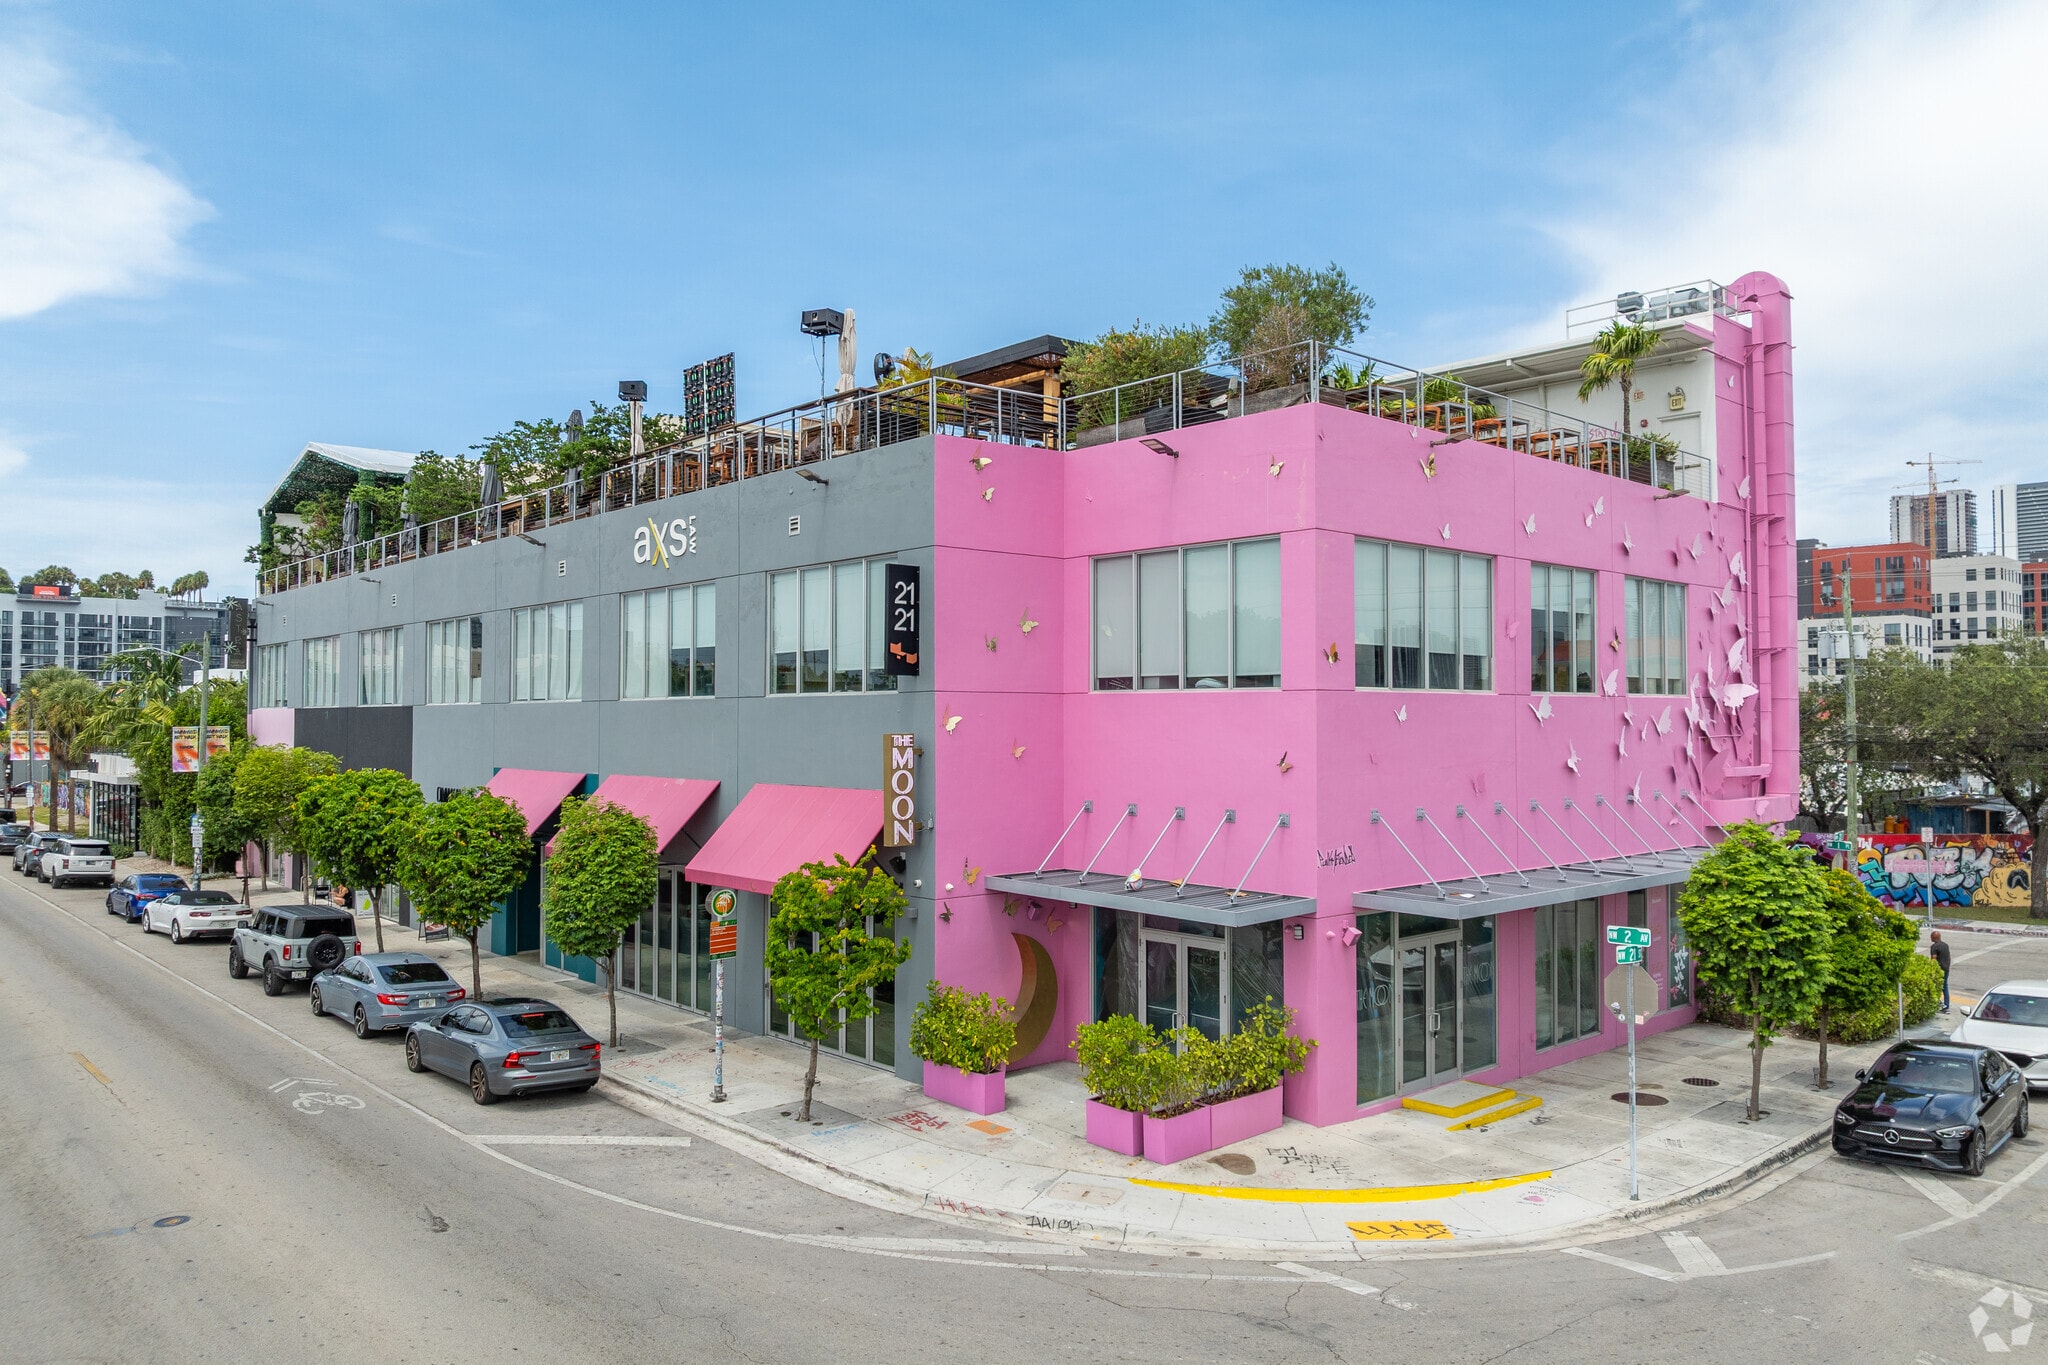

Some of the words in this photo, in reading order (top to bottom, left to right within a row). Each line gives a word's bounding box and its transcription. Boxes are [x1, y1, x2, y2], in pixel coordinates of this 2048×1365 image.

[1634, 391, 1644, 400] EXIT
[1671, 398, 1682, 407] EXIT
[689, 515, 697, 554] LAW
[894, 581, 915, 605] 21
[894, 608, 915, 632] 21
[892, 735, 914, 746] THE
[891, 747, 915, 845] MOON
[1609, 930, 1618, 940] NW
[1624, 930, 1632, 943] 2
[1640, 933, 1649, 943] AV
[1618, 951, 1626, 961] NW
